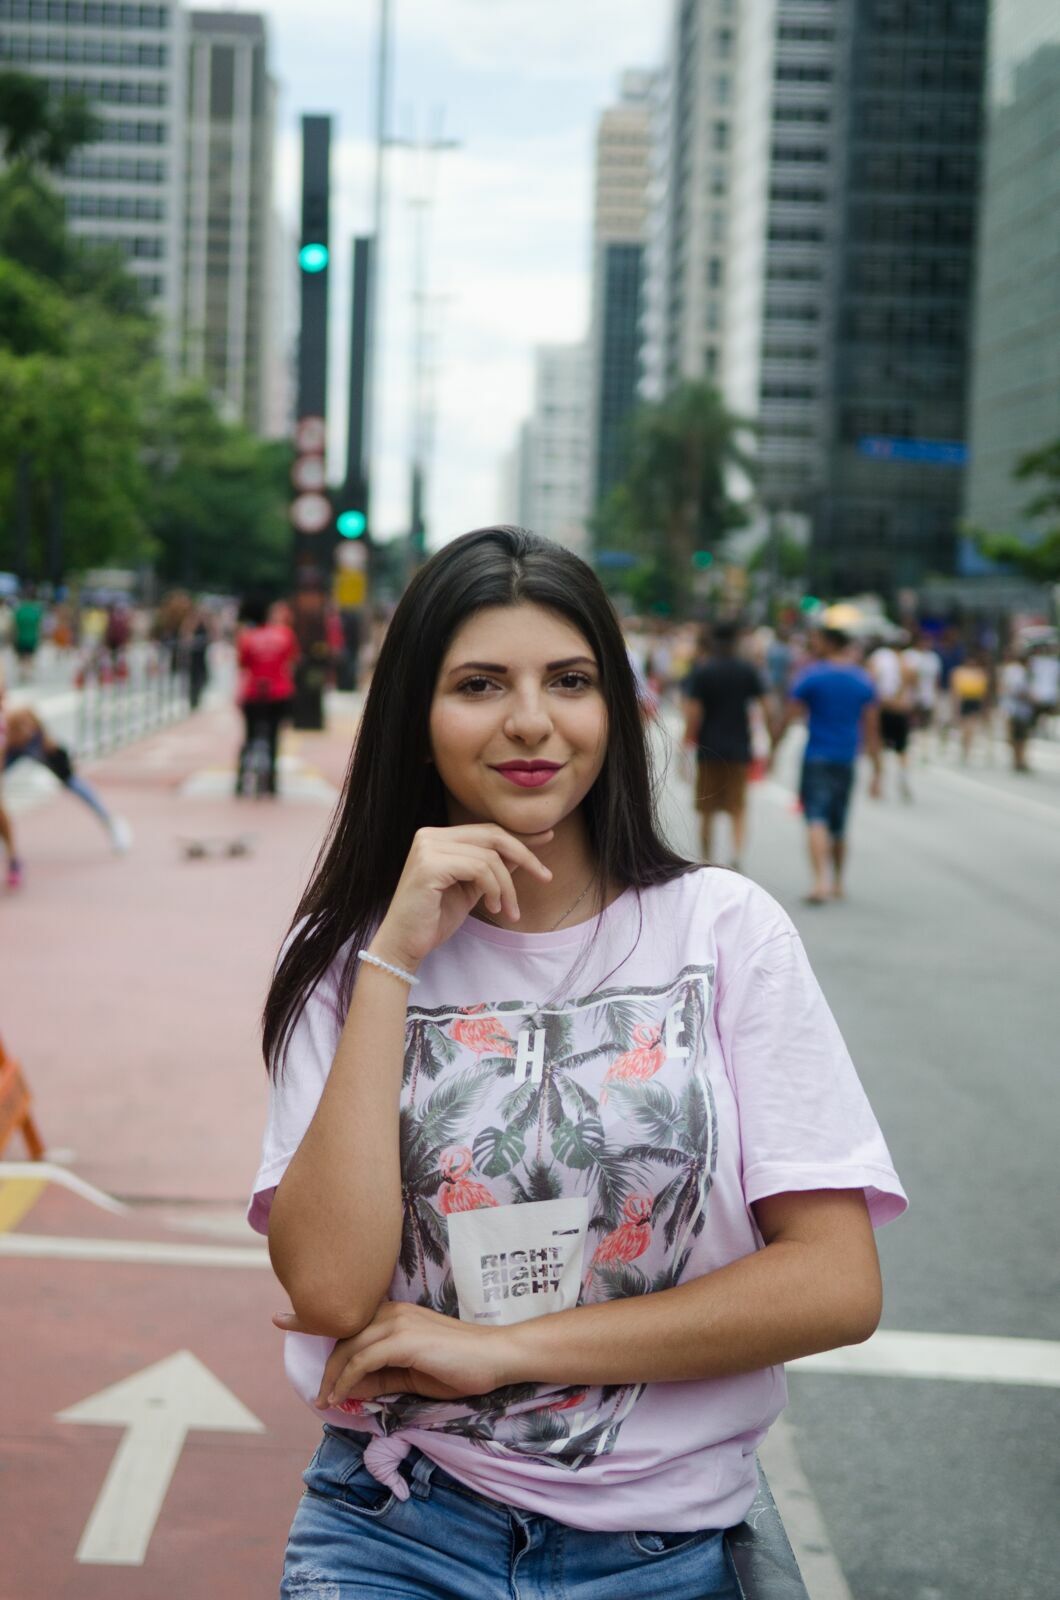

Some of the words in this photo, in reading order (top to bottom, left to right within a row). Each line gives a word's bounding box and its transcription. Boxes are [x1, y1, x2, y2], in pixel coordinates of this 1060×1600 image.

[514, 1029, 546, 1083] H
[666, 1000, 690, 1058] E
[480, 1247, 562, 1270] RIGHT
[481, 1263, 564, 1287] RIGHT
[483, 1280, 560, 1303] RIGHT
